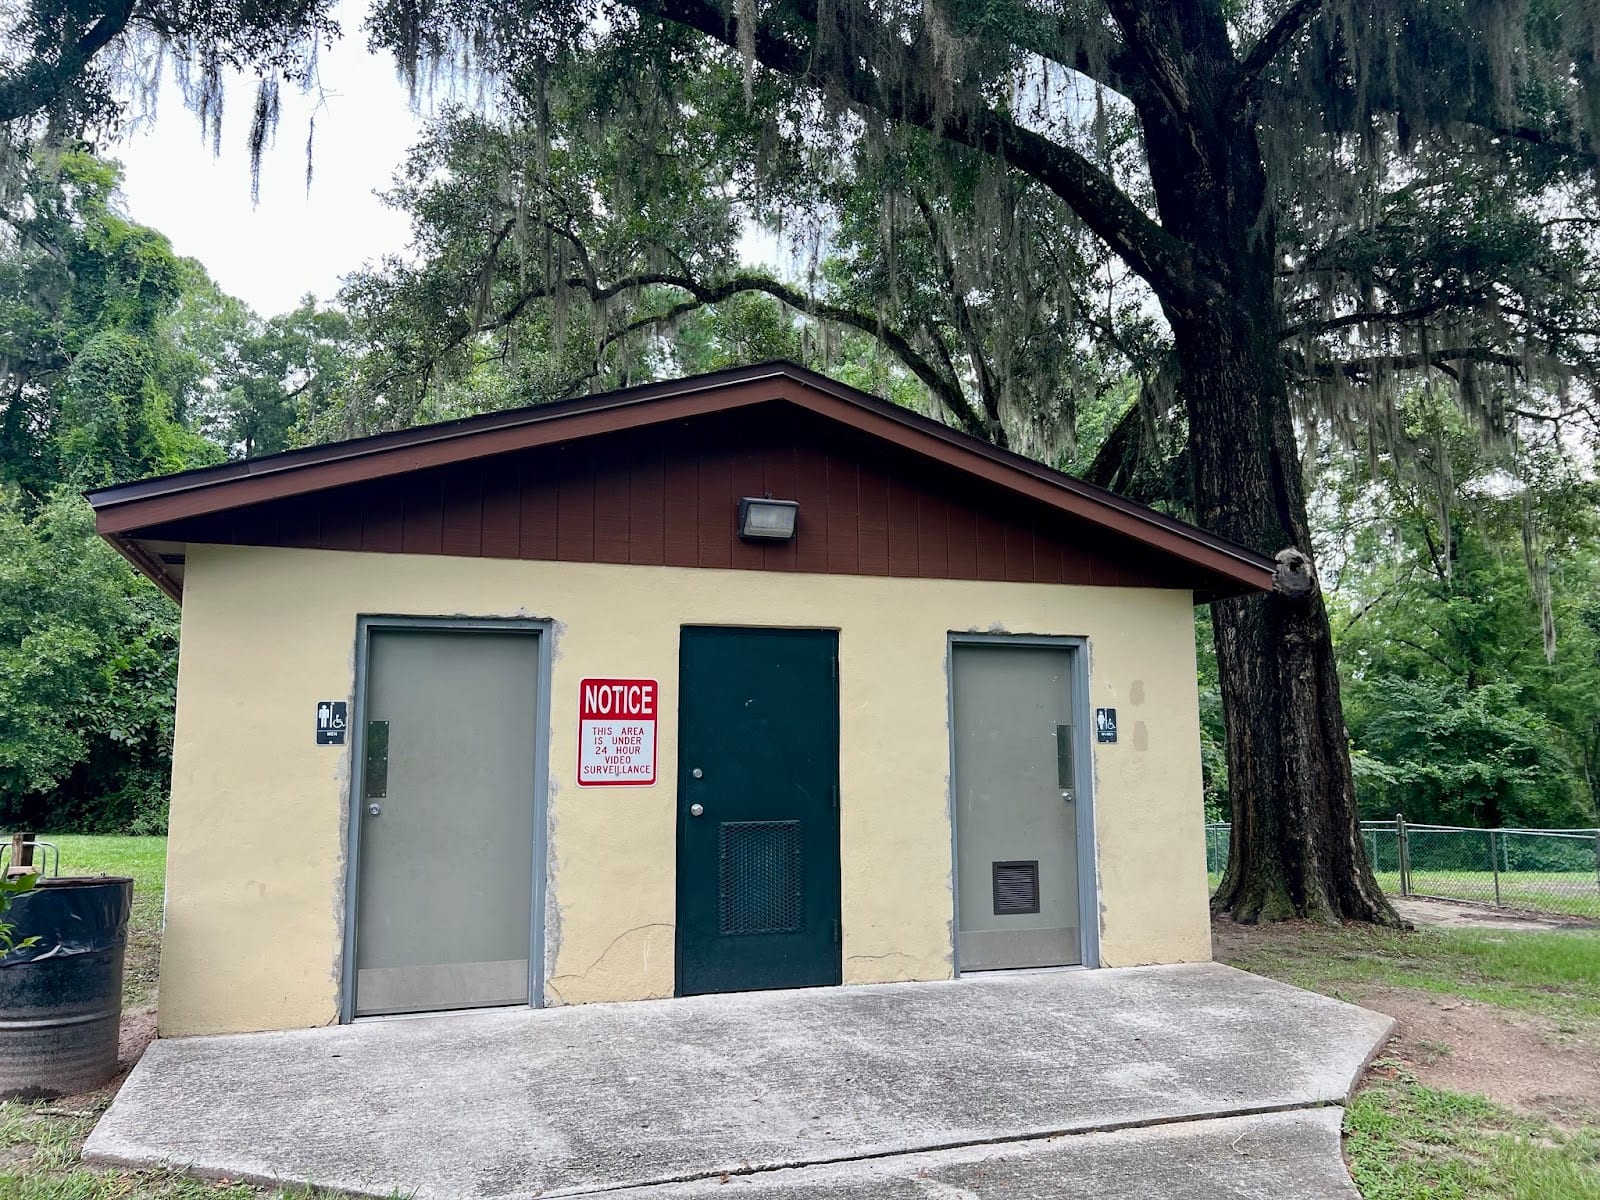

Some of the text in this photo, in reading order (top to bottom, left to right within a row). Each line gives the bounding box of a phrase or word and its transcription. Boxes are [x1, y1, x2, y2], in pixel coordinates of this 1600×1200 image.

[585, 685, 652, 714] NOTICE
[592, 727, 645, 736] THIS AREA
[594, 737, 642, 745] IS UNDER
[595, 746, 641, 755] 24 HOUR
[605, 756, 631, 765] VIDEO
[584, 765, 651, 774] SURVEILLANCE
